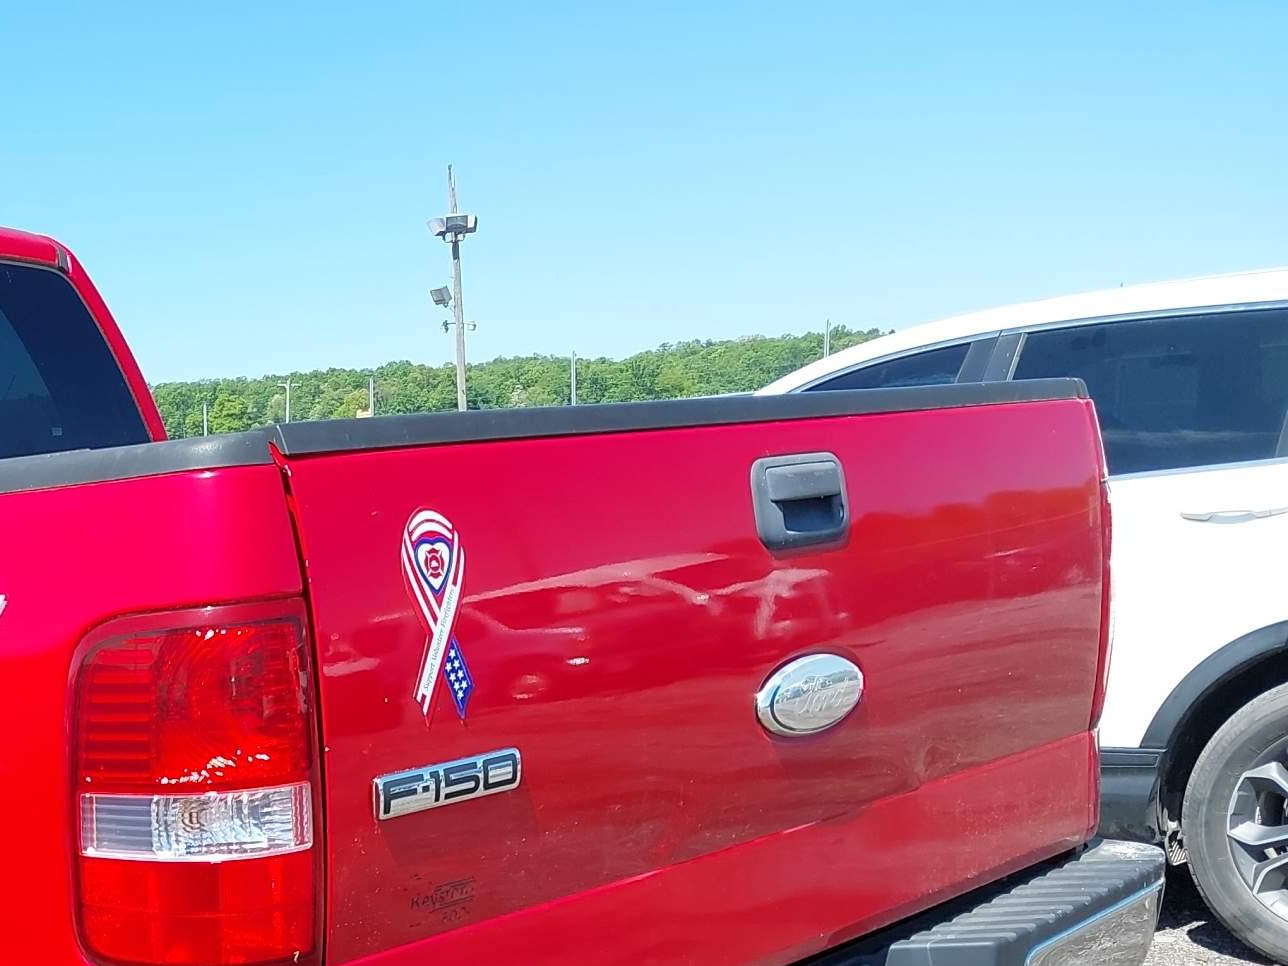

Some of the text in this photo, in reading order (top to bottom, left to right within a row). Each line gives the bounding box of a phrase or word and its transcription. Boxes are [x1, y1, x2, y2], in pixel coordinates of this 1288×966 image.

[423, 663, 436, 691] Support
[431, 629, 444, 661] Volunteer
[383, 752, 518, 815] F-150
